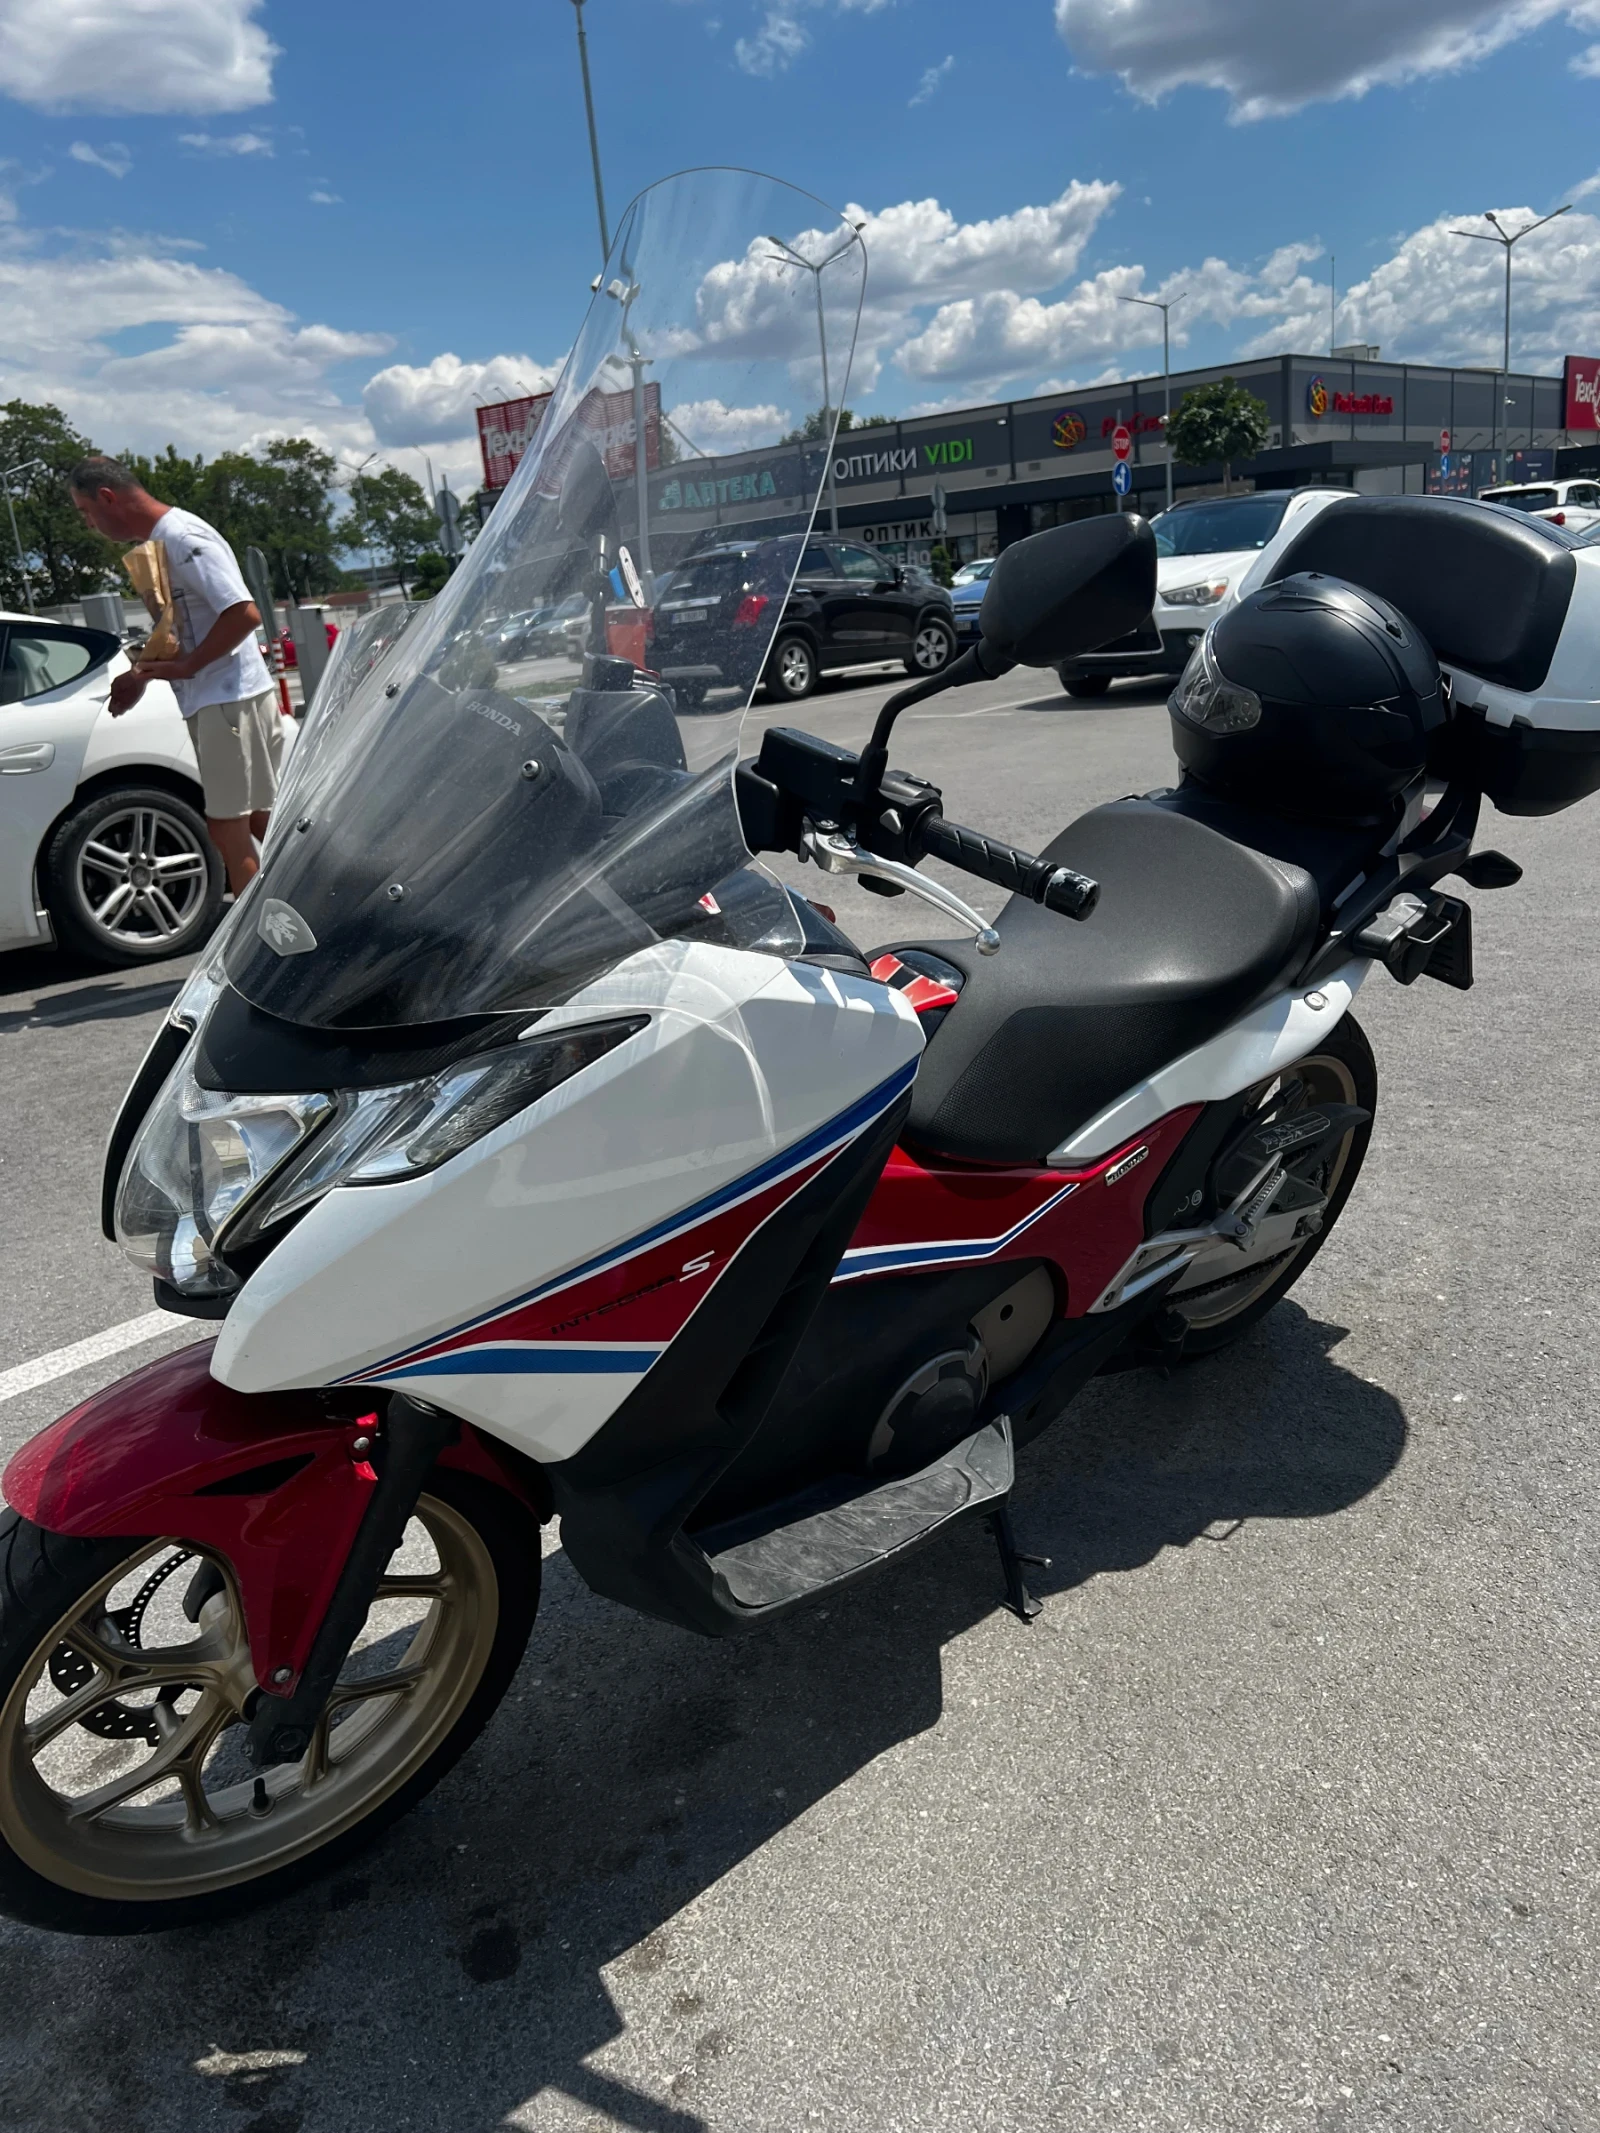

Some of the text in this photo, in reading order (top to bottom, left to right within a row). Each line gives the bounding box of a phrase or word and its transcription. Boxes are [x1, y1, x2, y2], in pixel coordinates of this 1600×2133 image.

[833, 438, 973, 480] ОПТИКИ VIDI
[1113, 437, 1130, 450] STOP
[684, 471, 776, 508] АПТЕКА
[466, 701, 522, 737] HONDA
[1112, 1152, 1145, 1180] HONDA
[679, 1249, 715, 1283] S
